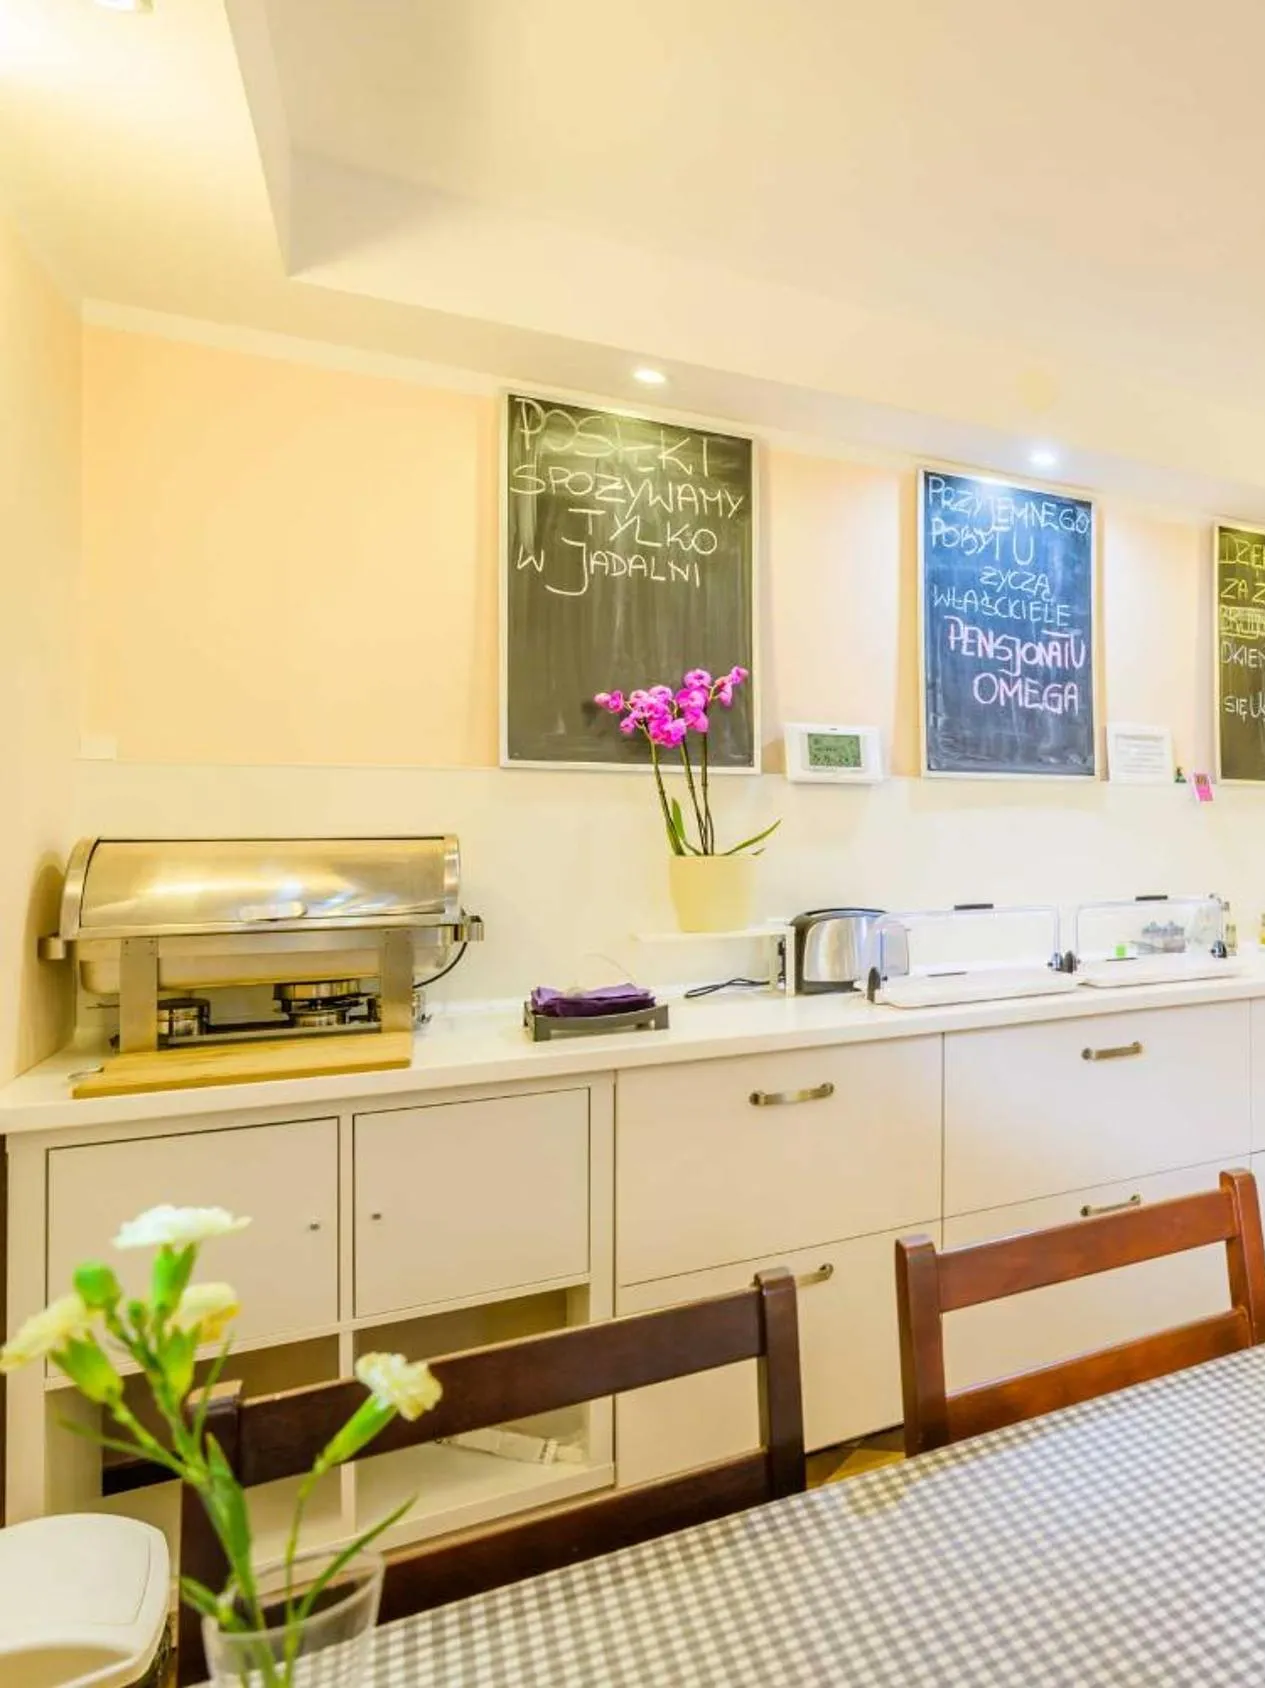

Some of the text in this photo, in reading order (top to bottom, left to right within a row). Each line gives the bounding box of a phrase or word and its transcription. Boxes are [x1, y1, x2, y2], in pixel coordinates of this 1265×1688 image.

[568, 508, 718, 555] TYLKO
[931, 516, 1035, 565] POBYTU
[516, 536, 701, 596] W JADALNI
[1220, 577, 1249, 600] ZA
[943, 615, 1087, 677] PENSJONATU
[972, 672, 1080, 716] OMEGA
[1223, 695, 1249, 723] SIĘ
